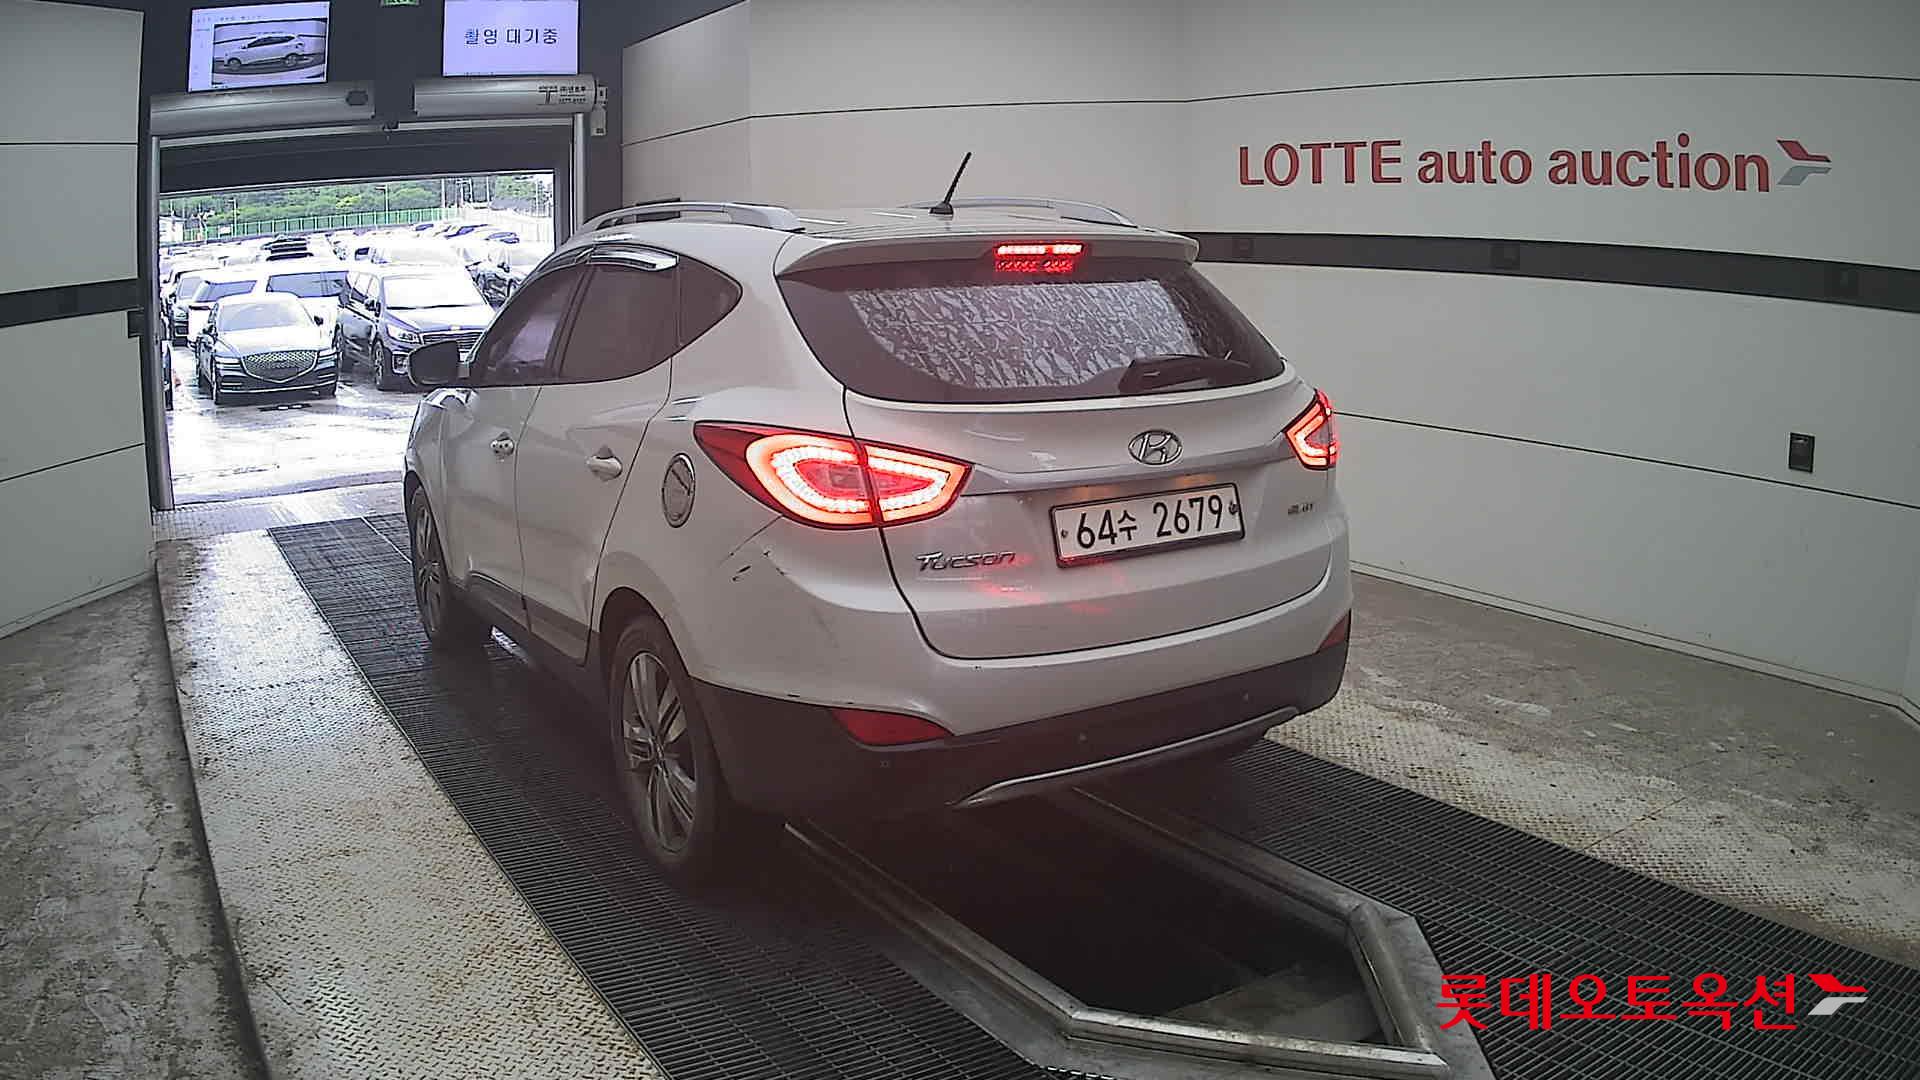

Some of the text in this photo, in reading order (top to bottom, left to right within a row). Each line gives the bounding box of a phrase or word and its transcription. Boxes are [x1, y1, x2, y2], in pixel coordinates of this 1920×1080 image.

[506, 28, 558, 45] 대기중
[1239, 132, 1771, 193] LOTTE auto auction
[1076, 494, 1224, 549] 64수 2679
[915, 551, 1017, 571] Tucson
